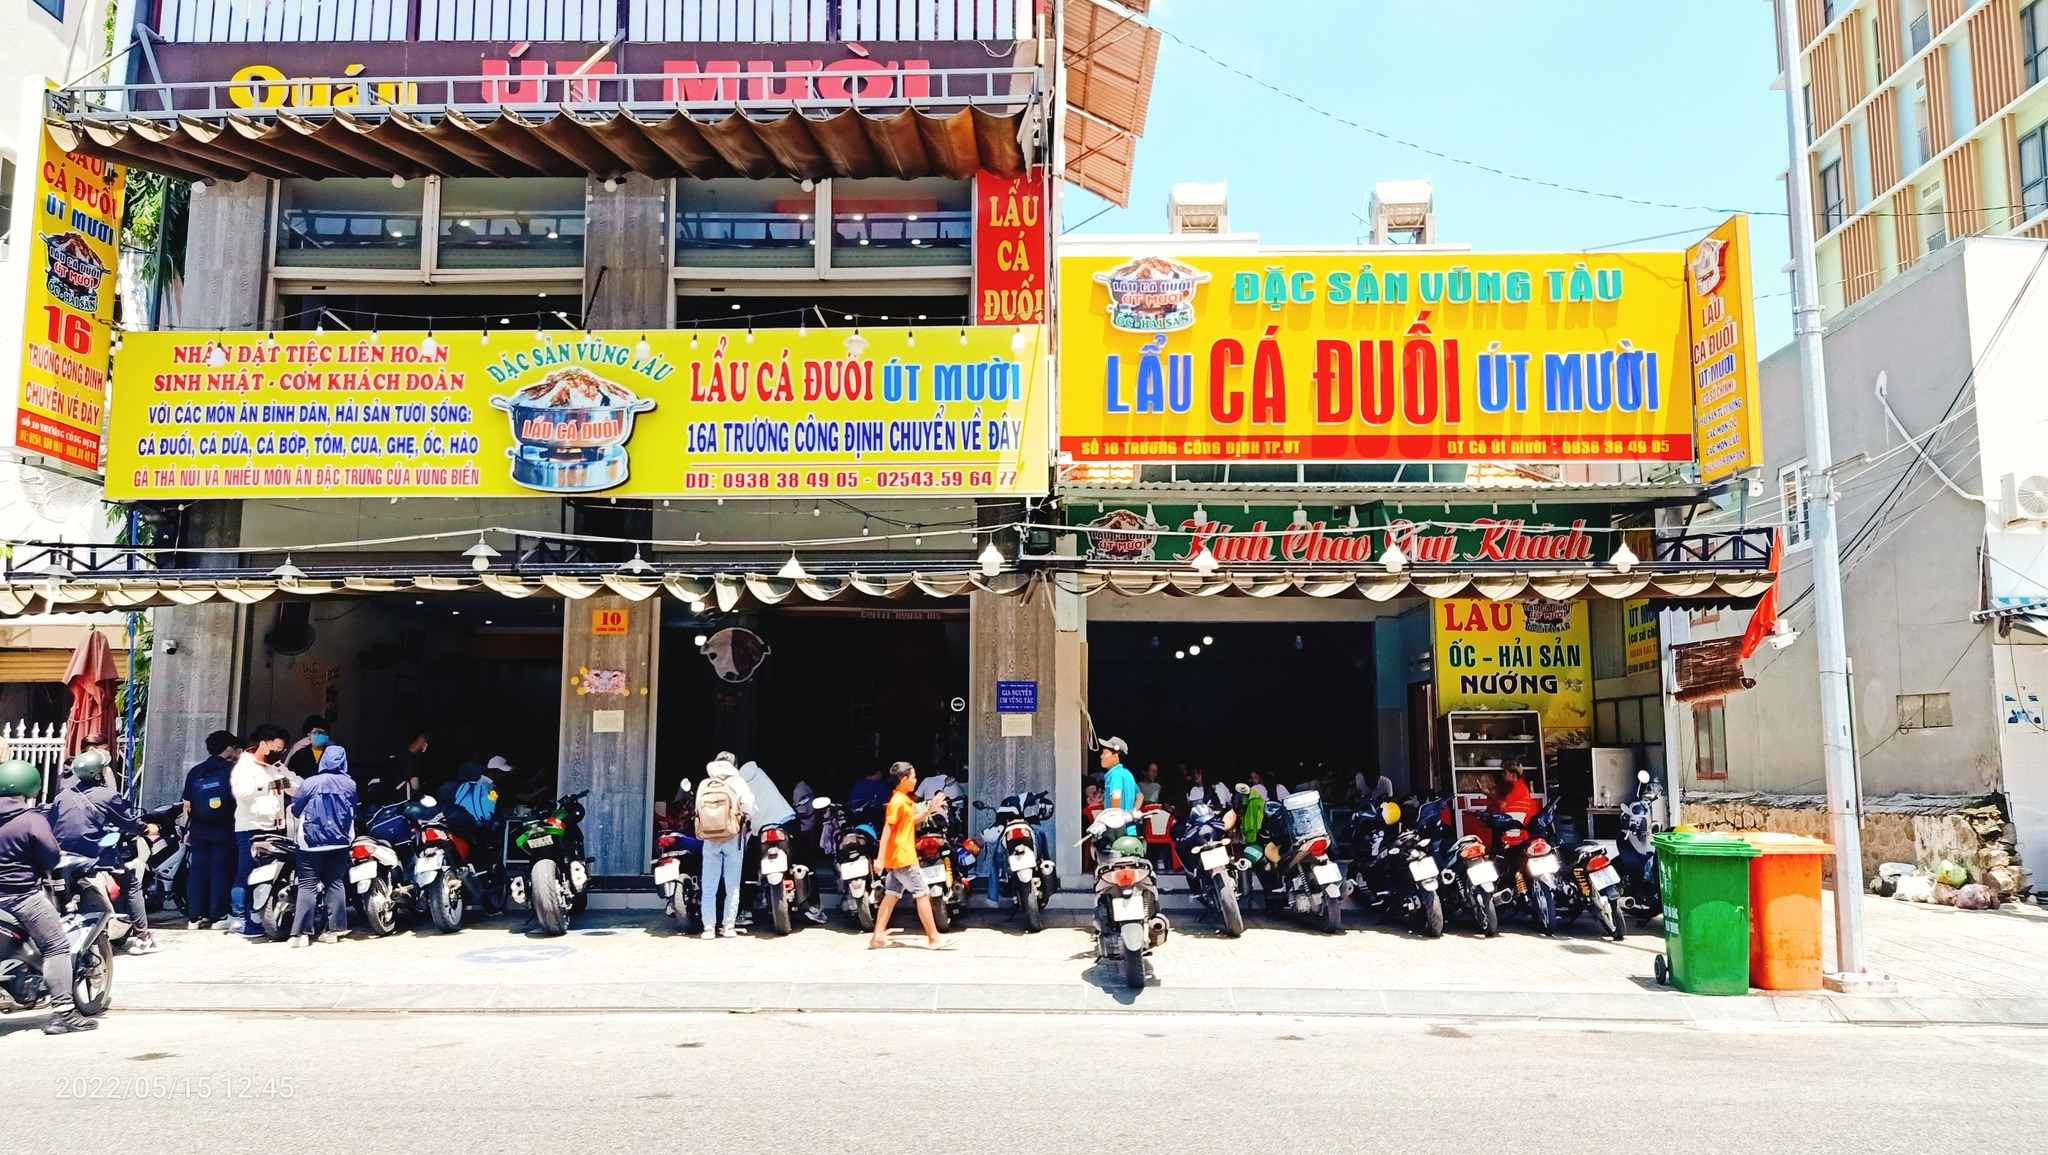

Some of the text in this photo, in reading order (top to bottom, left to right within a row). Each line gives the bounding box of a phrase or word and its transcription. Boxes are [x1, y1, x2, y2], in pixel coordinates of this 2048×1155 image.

[229, 41, 930, 108] Quán ÚT MƯỜI
[43, 160, 67, 192] CÁ
[997, 231, 1030, 272] CÁ
[983, 273, 1044, 321] ĐUỐI
[1233, 263, 1622, 310] ĐẶC SẢN VŨNG TÀU
[44, 305, 91, 354] 16
[238, 341, 281, 366] ĐẶT
[286, 341, 332, 367] TIỆC
[338, 341, 385, 363] LIÊN
[486, 352, 530, 383] ĐẶC
[532, 337, 570, 367] SẢN
[576, 338, 630, 366] VŨNG
[691, 336, 749, 401] LẨU
[757, 349, 794, 401] CÁ
[884, 358, 920, 401] ÚT
[934, 357, 1020, 401] MƯỜI
[1106, 310, 1660, 425] LẨU CÁ ĐUỐI ÚT MƯỜI
[154, 374, 202, 391] SINH
[207, 369, 264, 395] NHẬT
[280, 371, 322, 391] CƠM
[328, 369, 400, 391] KHÁCH
[406, 369, 464, 391] ĐOÀN
[26, 380, 65, 414] CHUYỂN
[67, 392, 79, 419] VỀ
[149, 399, 472, 425] VỚI CÁC MÓN ĂN BÌNH DÂN, HẢI SẢN TƯƠI SỐNG:
[138, 430, 478, 459] CÁ ĐUỐI, CÁ DỨA, CÁ BỚP, TÔM, CUA, GHẸ, ỐC, HÀO
[687, 404, 1021, 458] 16A TRƯƠNG CÔNG ĐỊNH CHUYỂN VỀ ĐÂY
[1183, 439, 1221, 455] CÔNG
[1264, 441, 1301, 455] TP.VT
[1562, 440, 1599, 454] 0938
[1604, 440, 1623, 454] 38
[1628, 440, 1647, 454] 49
[1652, 440, 1670, 454] 05
[134, 467, 148, 487] GÀ
[154, 464, 175, 486] THẢ
[180, 466, 200, 486] NÚI
[205, 466, 219, 485] VÀ
[224, 461, 260, 485] NHIỀU
[264, 466, 291, 485] MÓN
[316, 466, 340, 489] ĐẶC
[345, 466, 382, 485] TRƯNG
[386, 463, 410, 485] CỦA
[416, 466, 447, 485] VÙNG
[451, 461, 479, 485] BIỂN
[723, 472, 769, 488] 0938
[777, 472, 799, 488] 38
[807, 472, 829, 488] 49
[836, 472, 858, 487] 05
[877, 471, 962, 487] 02543.59
[970, 471, 992, 487] 64
[1174, 518, 1276, 561] Kính
[1281, 519, 1371, 561] Chào
[1464, 518, 1594, 561] Khách
[602, 612, 622, 626] 10
[1449, 639, 1476, 668] ỐC
[1499, 637, 1533, 667] HẢI
[1539, 637, 1581, 667] SẢN
[1460, 671, 1558, 695] NƯỚNG
